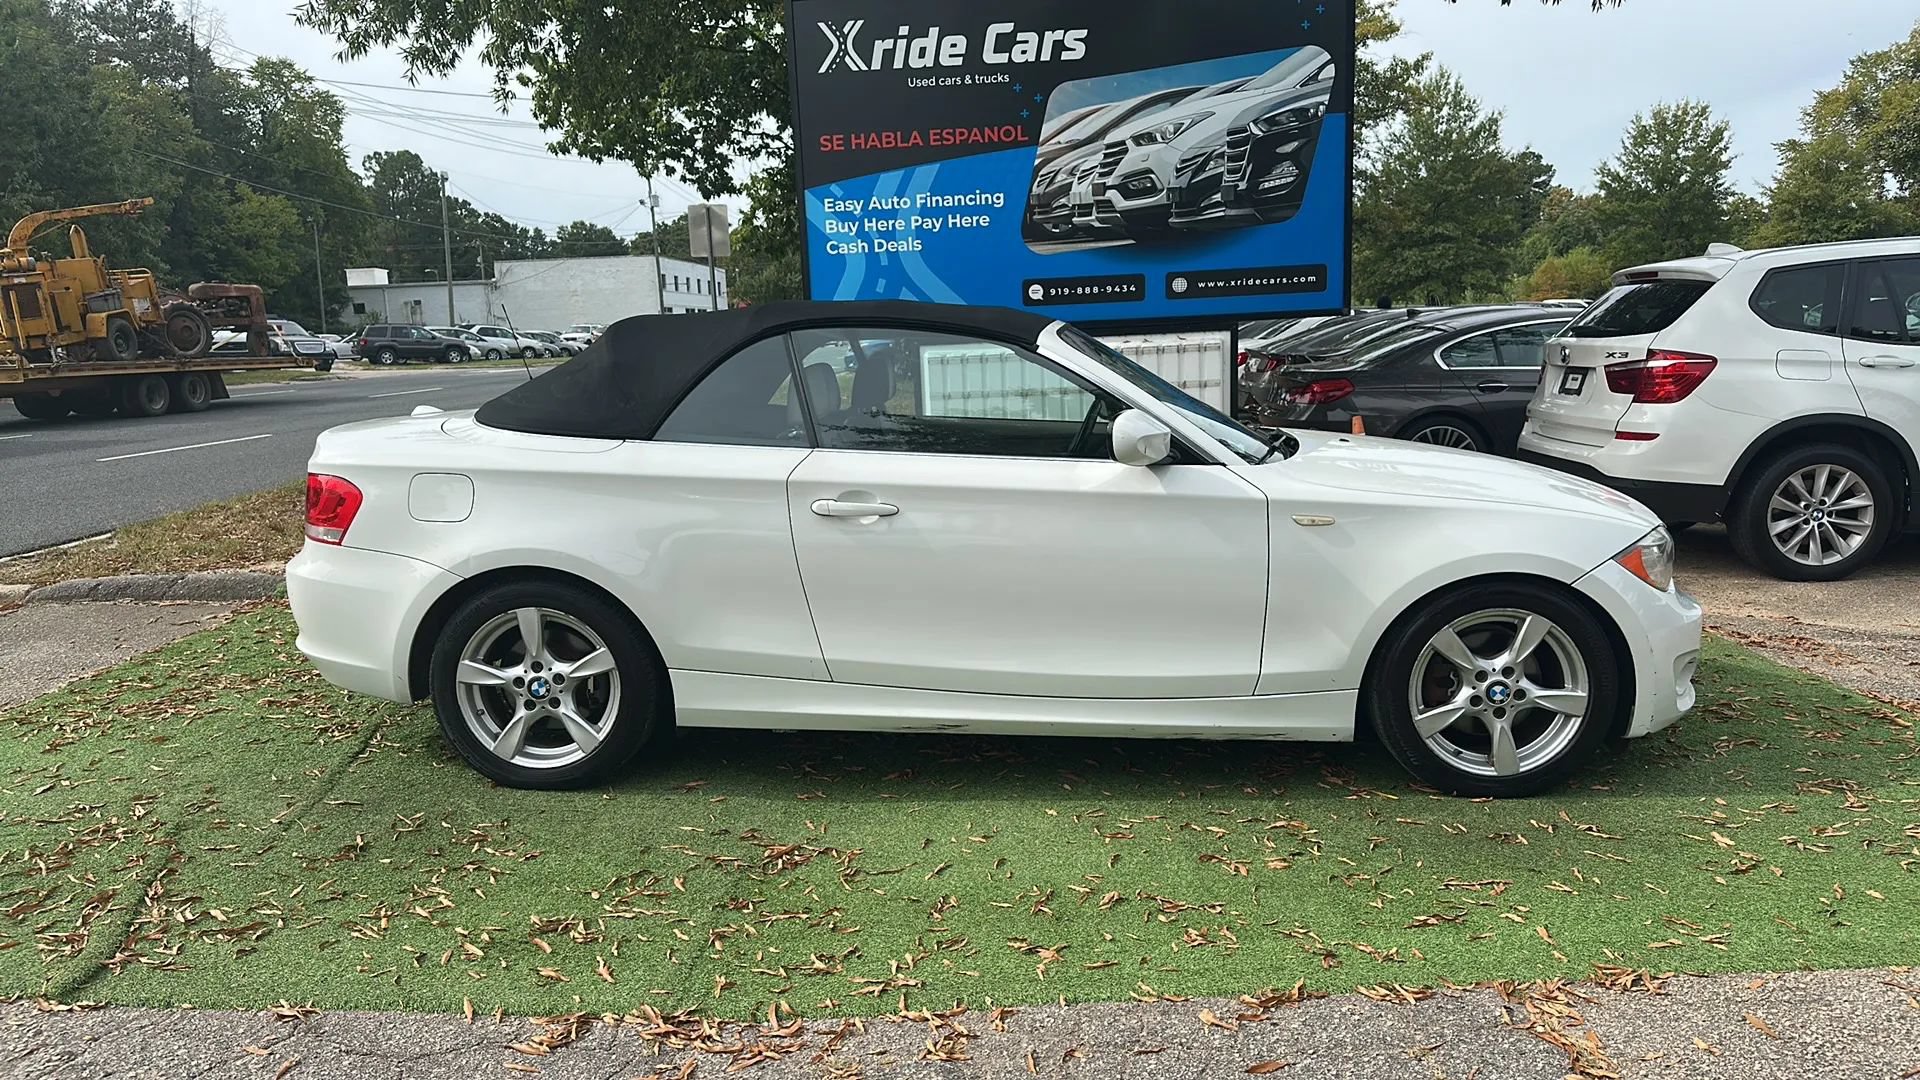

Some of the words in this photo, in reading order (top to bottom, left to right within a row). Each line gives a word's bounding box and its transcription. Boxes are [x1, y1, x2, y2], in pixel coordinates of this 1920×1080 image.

[817, 20, 967, 73] Xride
[982, 22, 1088, 64] Cars
[908, 77, 935, 87] Used
[938, 76, 961, 85] cars
[964, 74, 972, 83] &
[975, 73, 1009, 83] trucks
[820, 134, 844, 150] SE
[851, 130, 923, 149] HABLA
[929, 125, 1028, 145] ESPANOL
[824, 198, 863, 213] Easy
[868, 195, 910, 209] Auto
[916, 190, 1004, 208] Financing
[825, 219, 859, 236] Buy
[864, 217, 905, 231] Here
[911, 215, 943, 232] Pay
[948, 213, 990, 227] Here
[826, 240, 869, 254] Cash
[874, 237, 922, 252] Deals
[1049, 284, 1136, 296] 919-888-9434
[1198, 274, 1317, 288] www.xridecars.com
